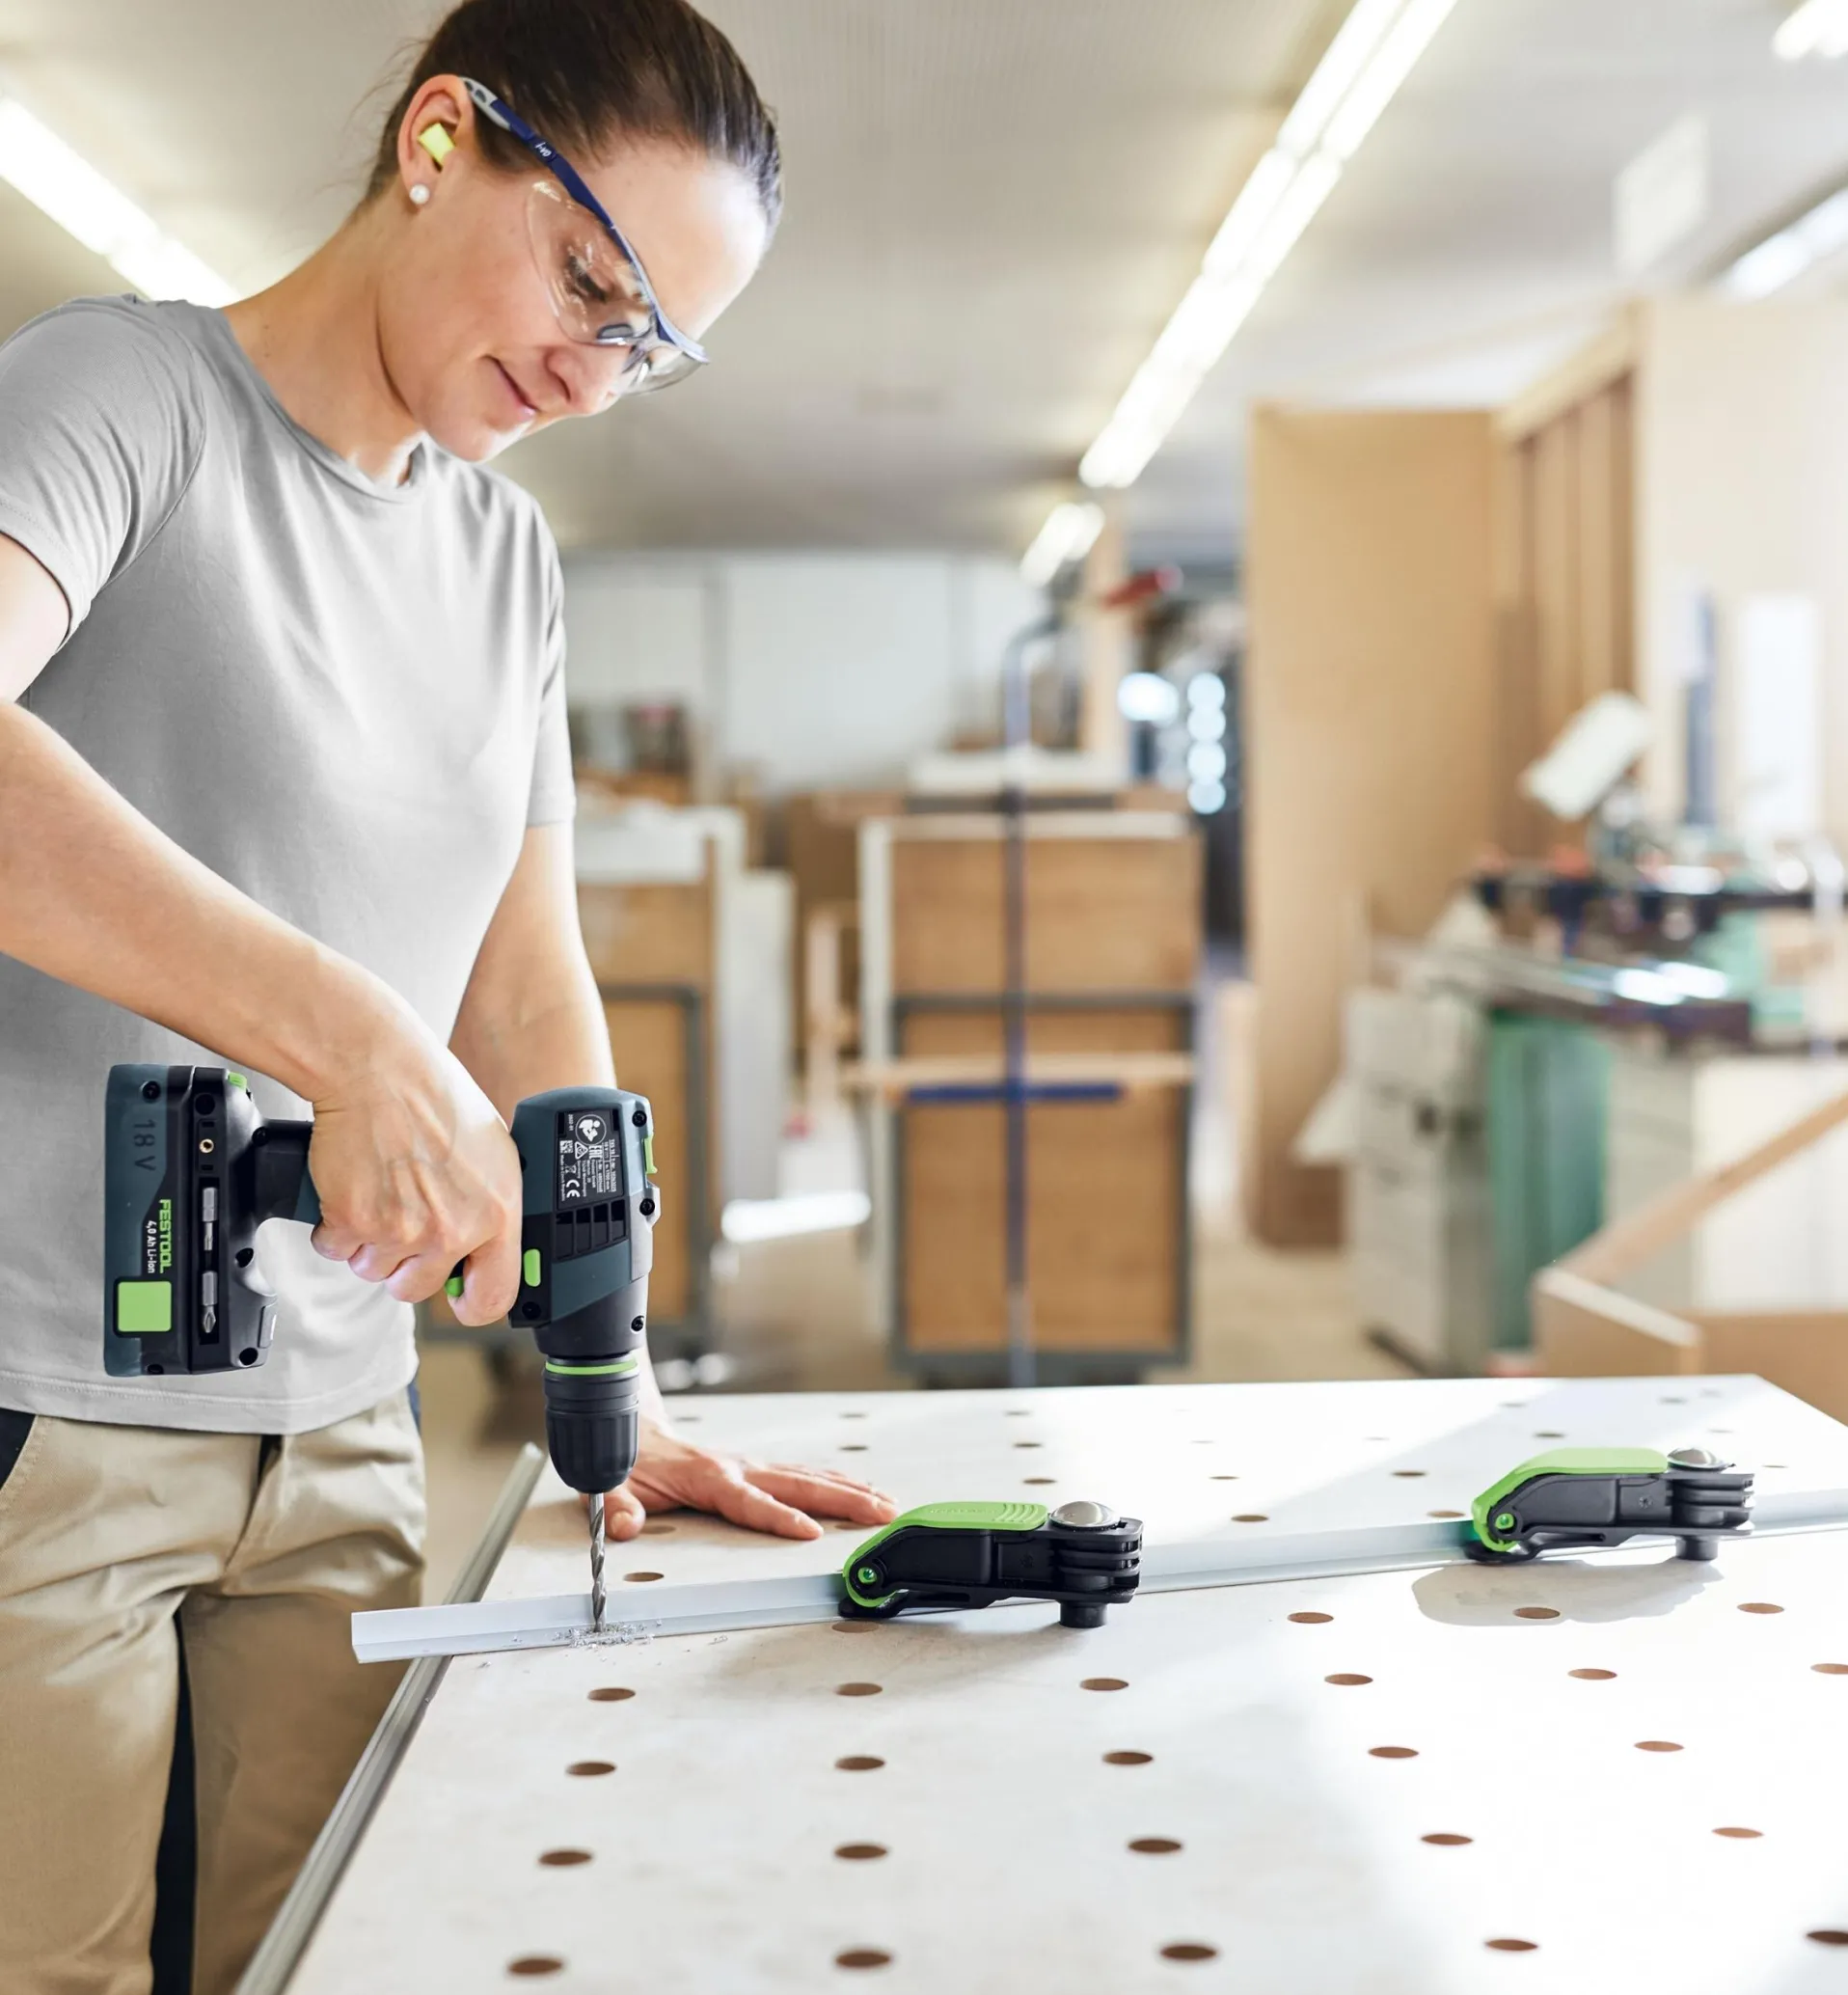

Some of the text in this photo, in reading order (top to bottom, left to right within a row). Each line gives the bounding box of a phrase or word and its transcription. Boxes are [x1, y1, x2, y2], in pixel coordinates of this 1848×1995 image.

[133, 1120, 155, 1171] 18 V
[146, 1219, 156, 1273] 4,0 Ah Li-Ion
[159, 1199, 172, 1273] FESTOOL
